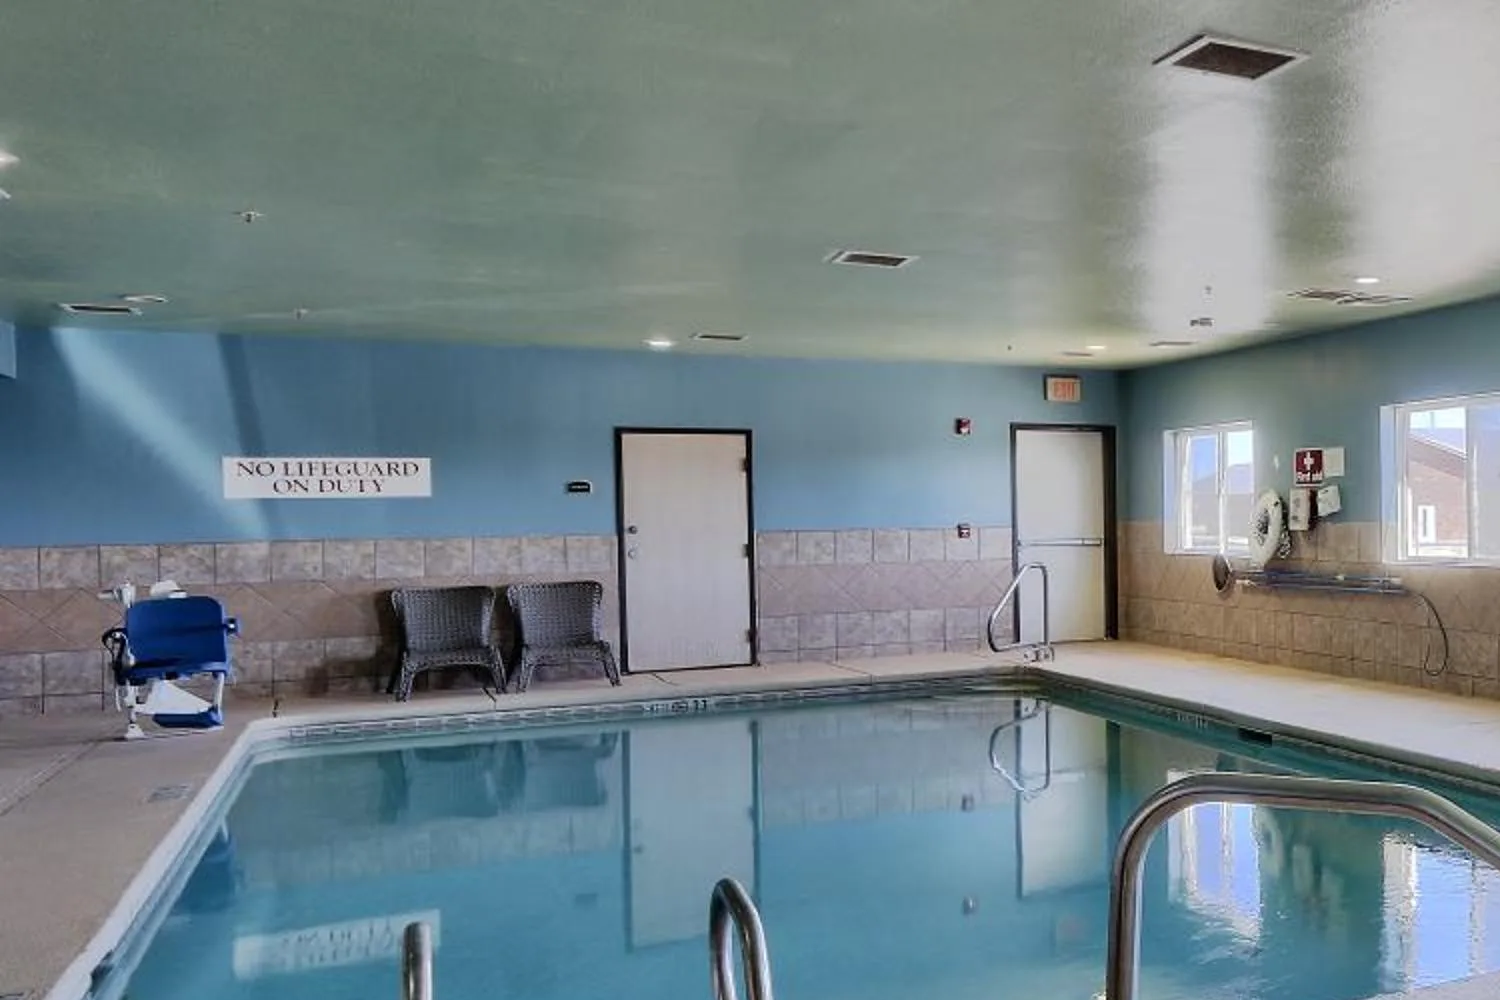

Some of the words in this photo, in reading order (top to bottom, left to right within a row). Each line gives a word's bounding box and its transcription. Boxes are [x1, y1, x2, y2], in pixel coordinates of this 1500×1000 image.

[238, 461, 275, 477] NO
[282, 461, 420, 477] LIFEGUARD
[272, 479, 309, 494] ON
[319, 479, 385, 493] DUTY
